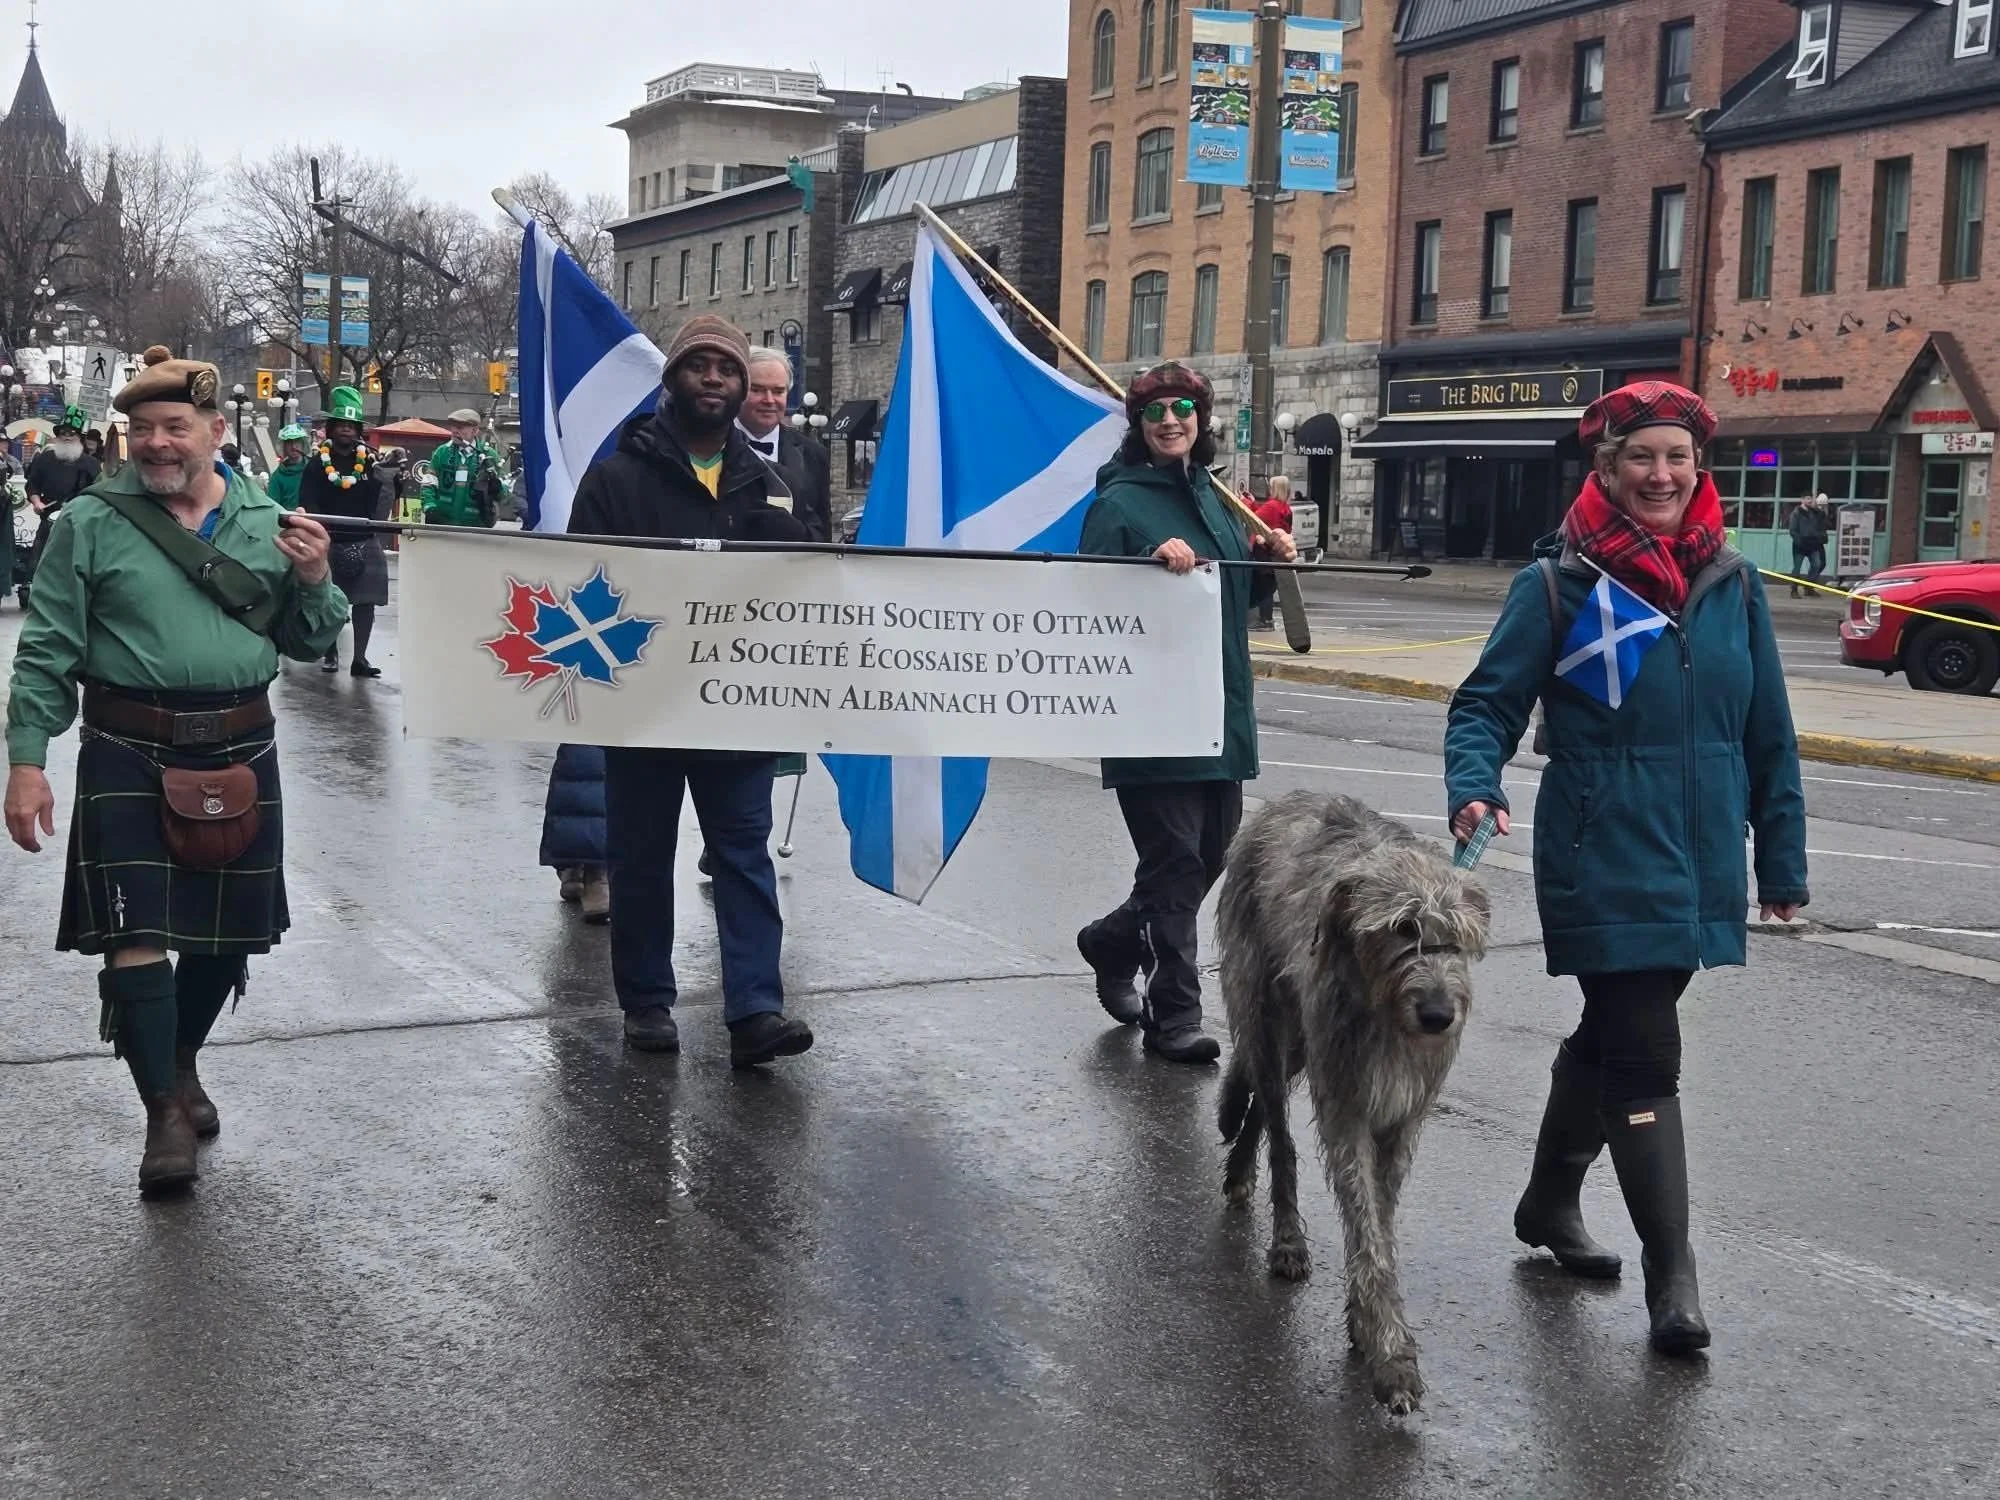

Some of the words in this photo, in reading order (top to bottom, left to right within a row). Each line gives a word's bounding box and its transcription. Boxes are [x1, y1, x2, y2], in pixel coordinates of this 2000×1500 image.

[1440, 385, 1466, 405] THE
[1471, 383, 1505, 404] BRIG
[1510, 382, 1540, 402] PUB
[1299, 444, 1334, 456] Masala
[684, 601, 737, 626] THE
[743, 598, 875, 627] SCOTTISH
[883, 602, 985, 633] SOCIETY
[992, 612, 1025, 634] OF
[1032, 609, 1146, 635] OTTAWA
[688, 640, 721, 664] LA
[729, 637, 849, 668] SOCIÉTÉ
[857, 636, 988, 674] ÉCOSSAISE
[996, 648, 1134, 676] D'OTTAWA
[699, 678, 833, 709] COMUNN
[837, 684, 997, 714] ALBANNACH
[1006, 689, 1118, 715] OTTAWA
